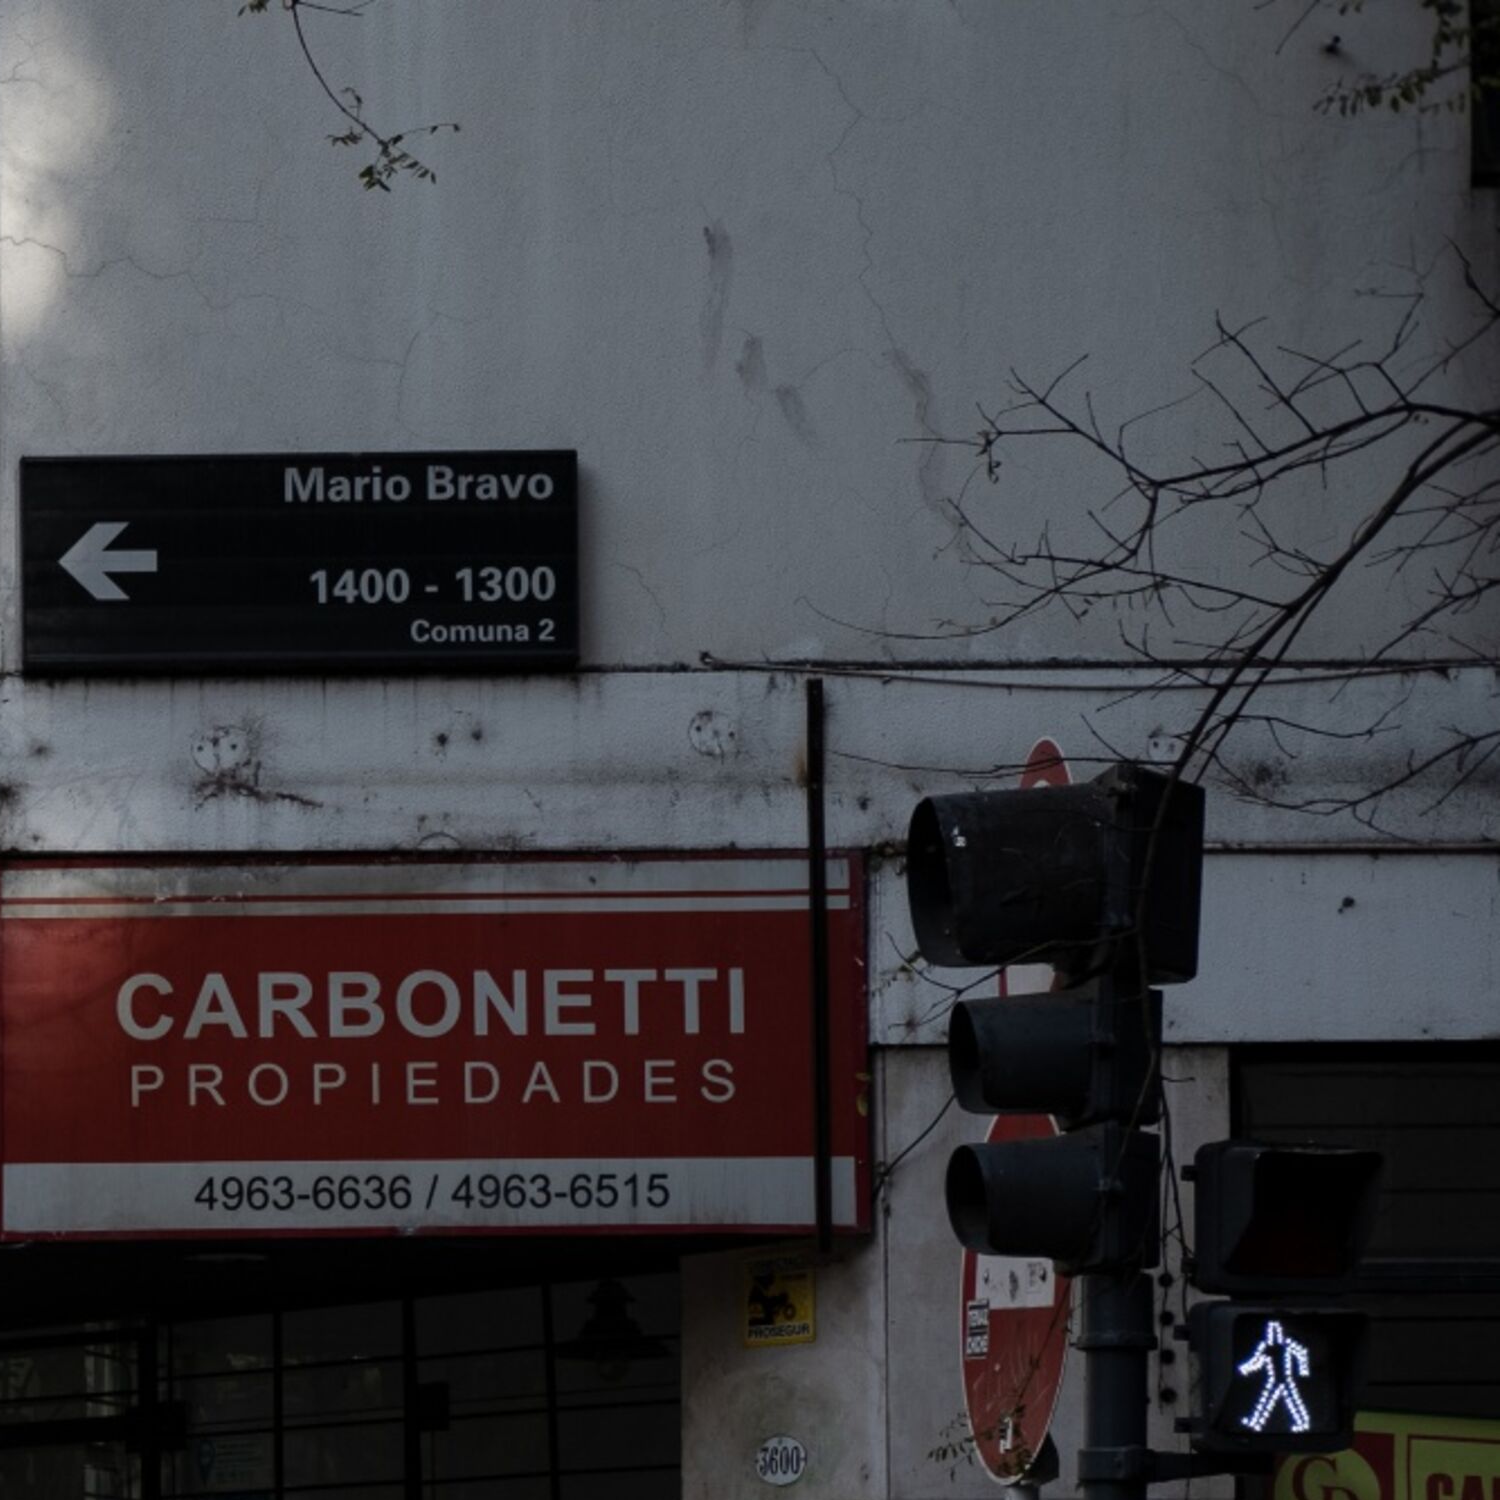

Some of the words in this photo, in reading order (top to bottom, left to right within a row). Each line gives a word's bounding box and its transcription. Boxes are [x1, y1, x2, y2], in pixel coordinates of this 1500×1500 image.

[283, 466, 411, 504] Mario
[425, 464, 555, 503] Bravo
[308, 567, 411, 605] 1400
[424, 585, 439, 594] -
[454, 566, 557, 604] 1300
[409, 618, 530, 644] Comuna
[538, 618, 556, 642] 2
[115, 966, 747, 1040] CARBONETTI
[129, 1058, 738, 1108] PROPIEDADES
[194, 1174, 412, 1212] 4963-6636
[425, 1174, 440, 1210] /
[451, 1171, 670, 1209] 4963-6515
[758, 1446, 801, 1477] 3600
